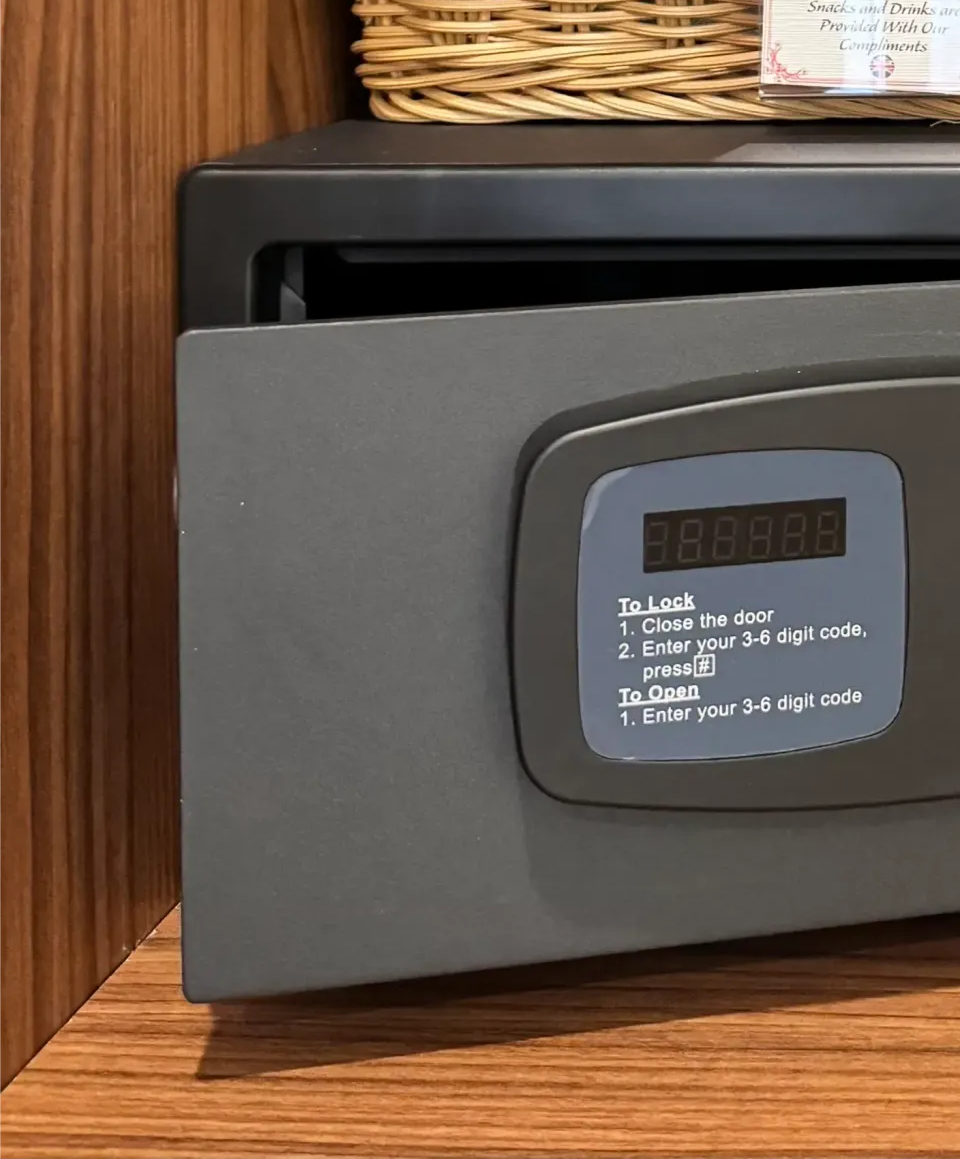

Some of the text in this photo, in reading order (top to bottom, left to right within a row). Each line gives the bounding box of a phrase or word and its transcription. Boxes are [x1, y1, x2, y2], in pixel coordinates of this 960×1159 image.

[807, 0, 856, 14] Snacks
[859, 0, 888, 14] and
[889, 1, 936, 16] Drinks
[820, 18, 951, 35] Provided With Our
[839, 36, 929, 56] Compliments
[618, 592, 695, 614] To Lock
[619, 609, 775, 637] 1. Close the door
[618, 621, 867, 660] 2. Enter your 3-6 digit code,
[643, 662, 693, 683] press
[618, 684, 700, 703] To Open
[620, 688, 863, 727] 1. Enter your 3-6 digit code
